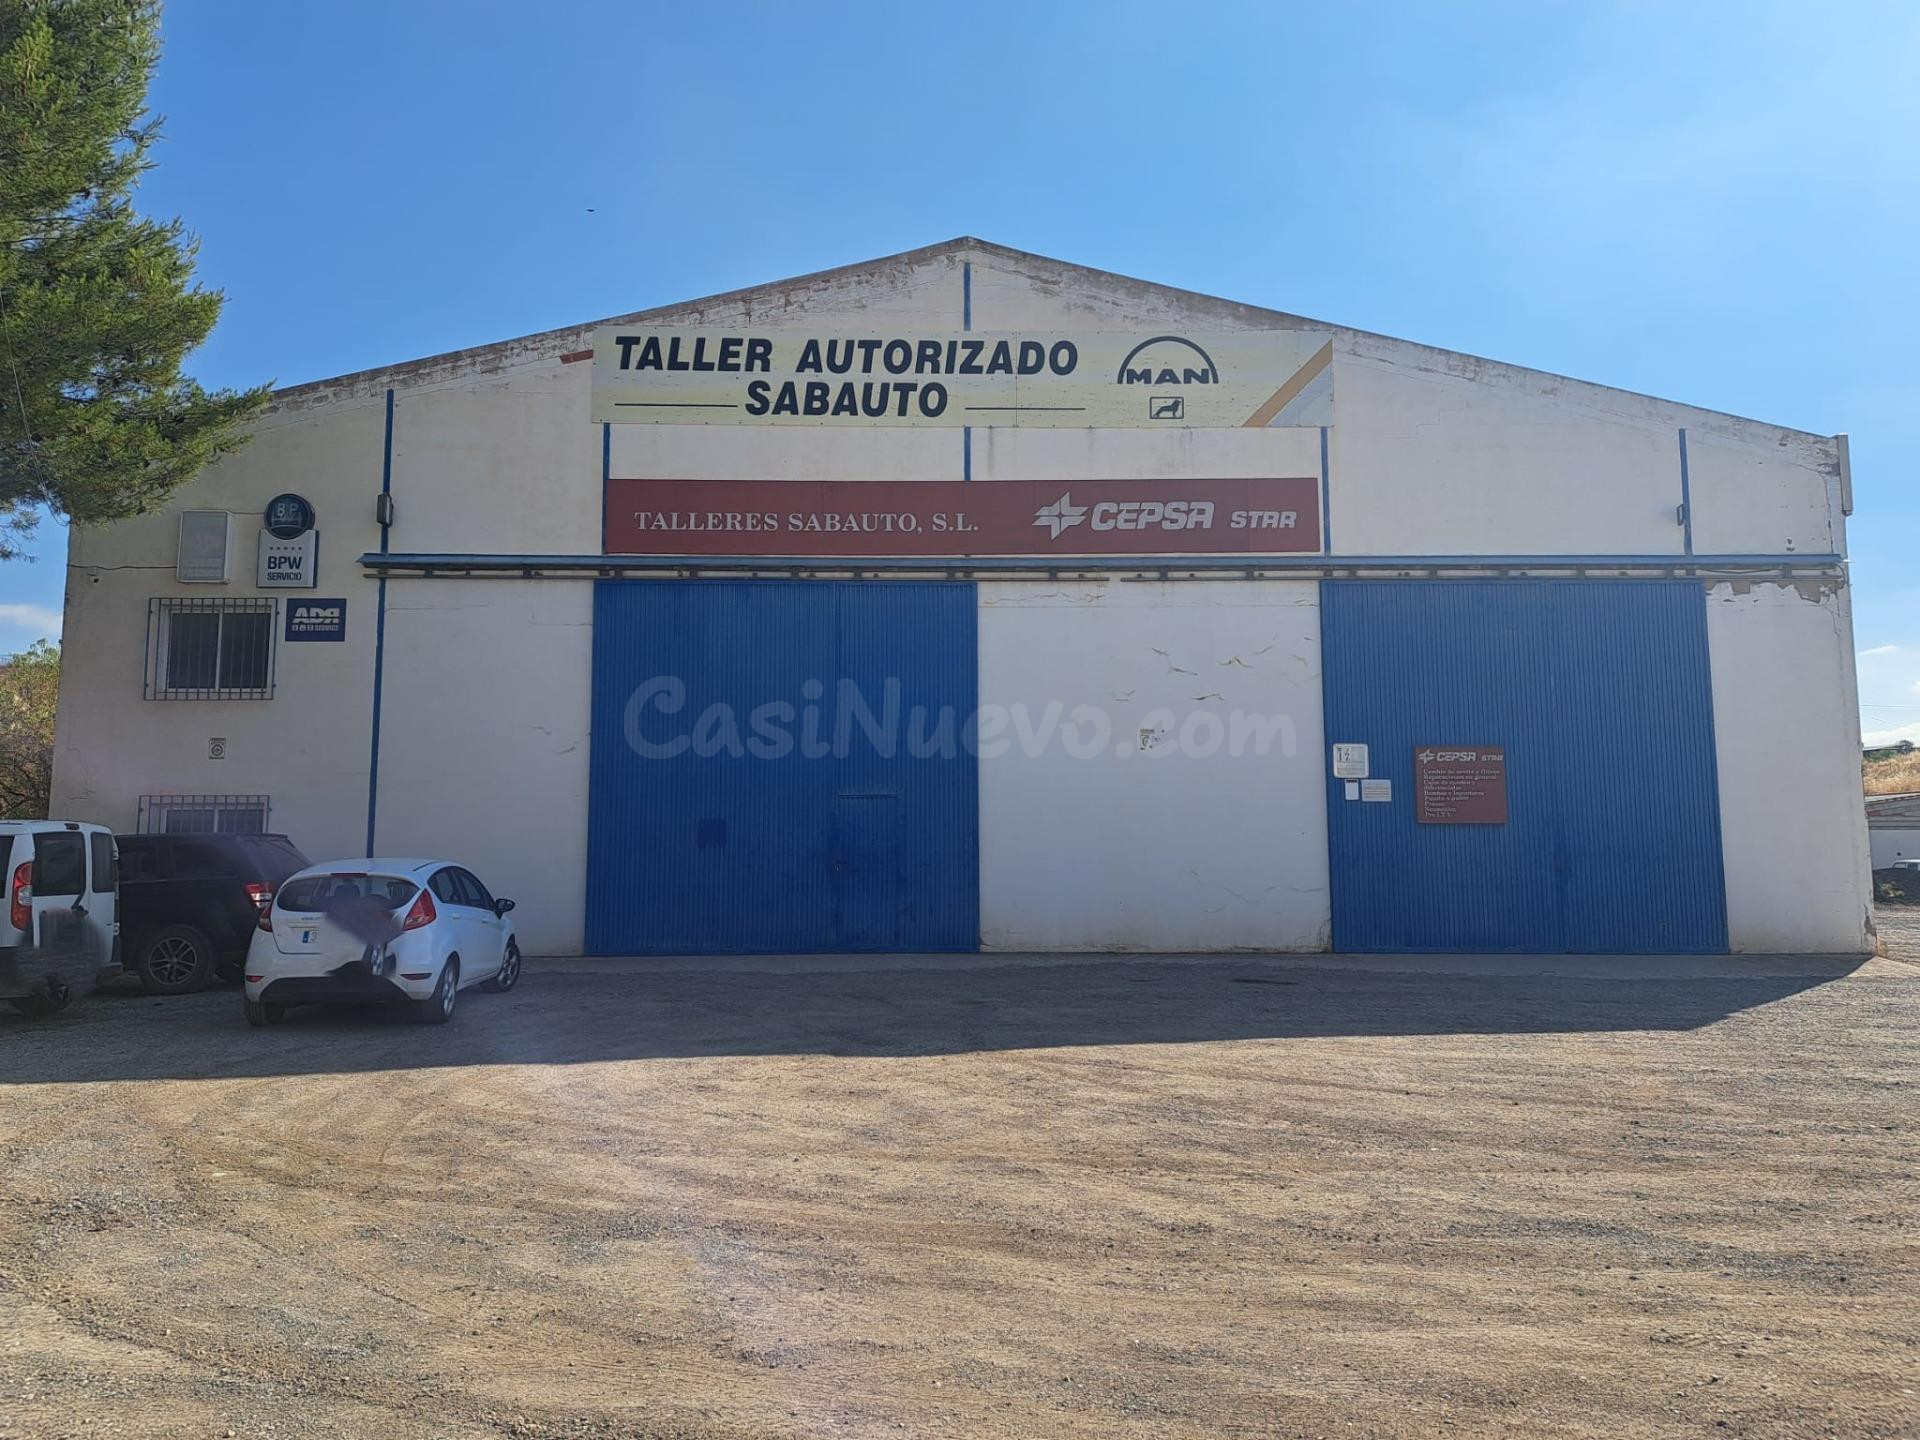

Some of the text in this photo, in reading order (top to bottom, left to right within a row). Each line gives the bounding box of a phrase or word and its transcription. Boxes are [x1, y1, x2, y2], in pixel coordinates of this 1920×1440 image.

[614, 335, 1079, 376] TALLER AUTORIZADO
[1125, 368, 1211, 385] MAN
[744, 380, 949, 418] SABAUTO
[633, 511, 980, 535] TALLERES SABAUTO, S.L.
[1090, 501, 1298, 532] CEPSA STAR
[267, 556, 302, 569] BPW
[266, 572, 302, 581] SERVICIO
[1436, 752, 1476, 761] CEPSA
